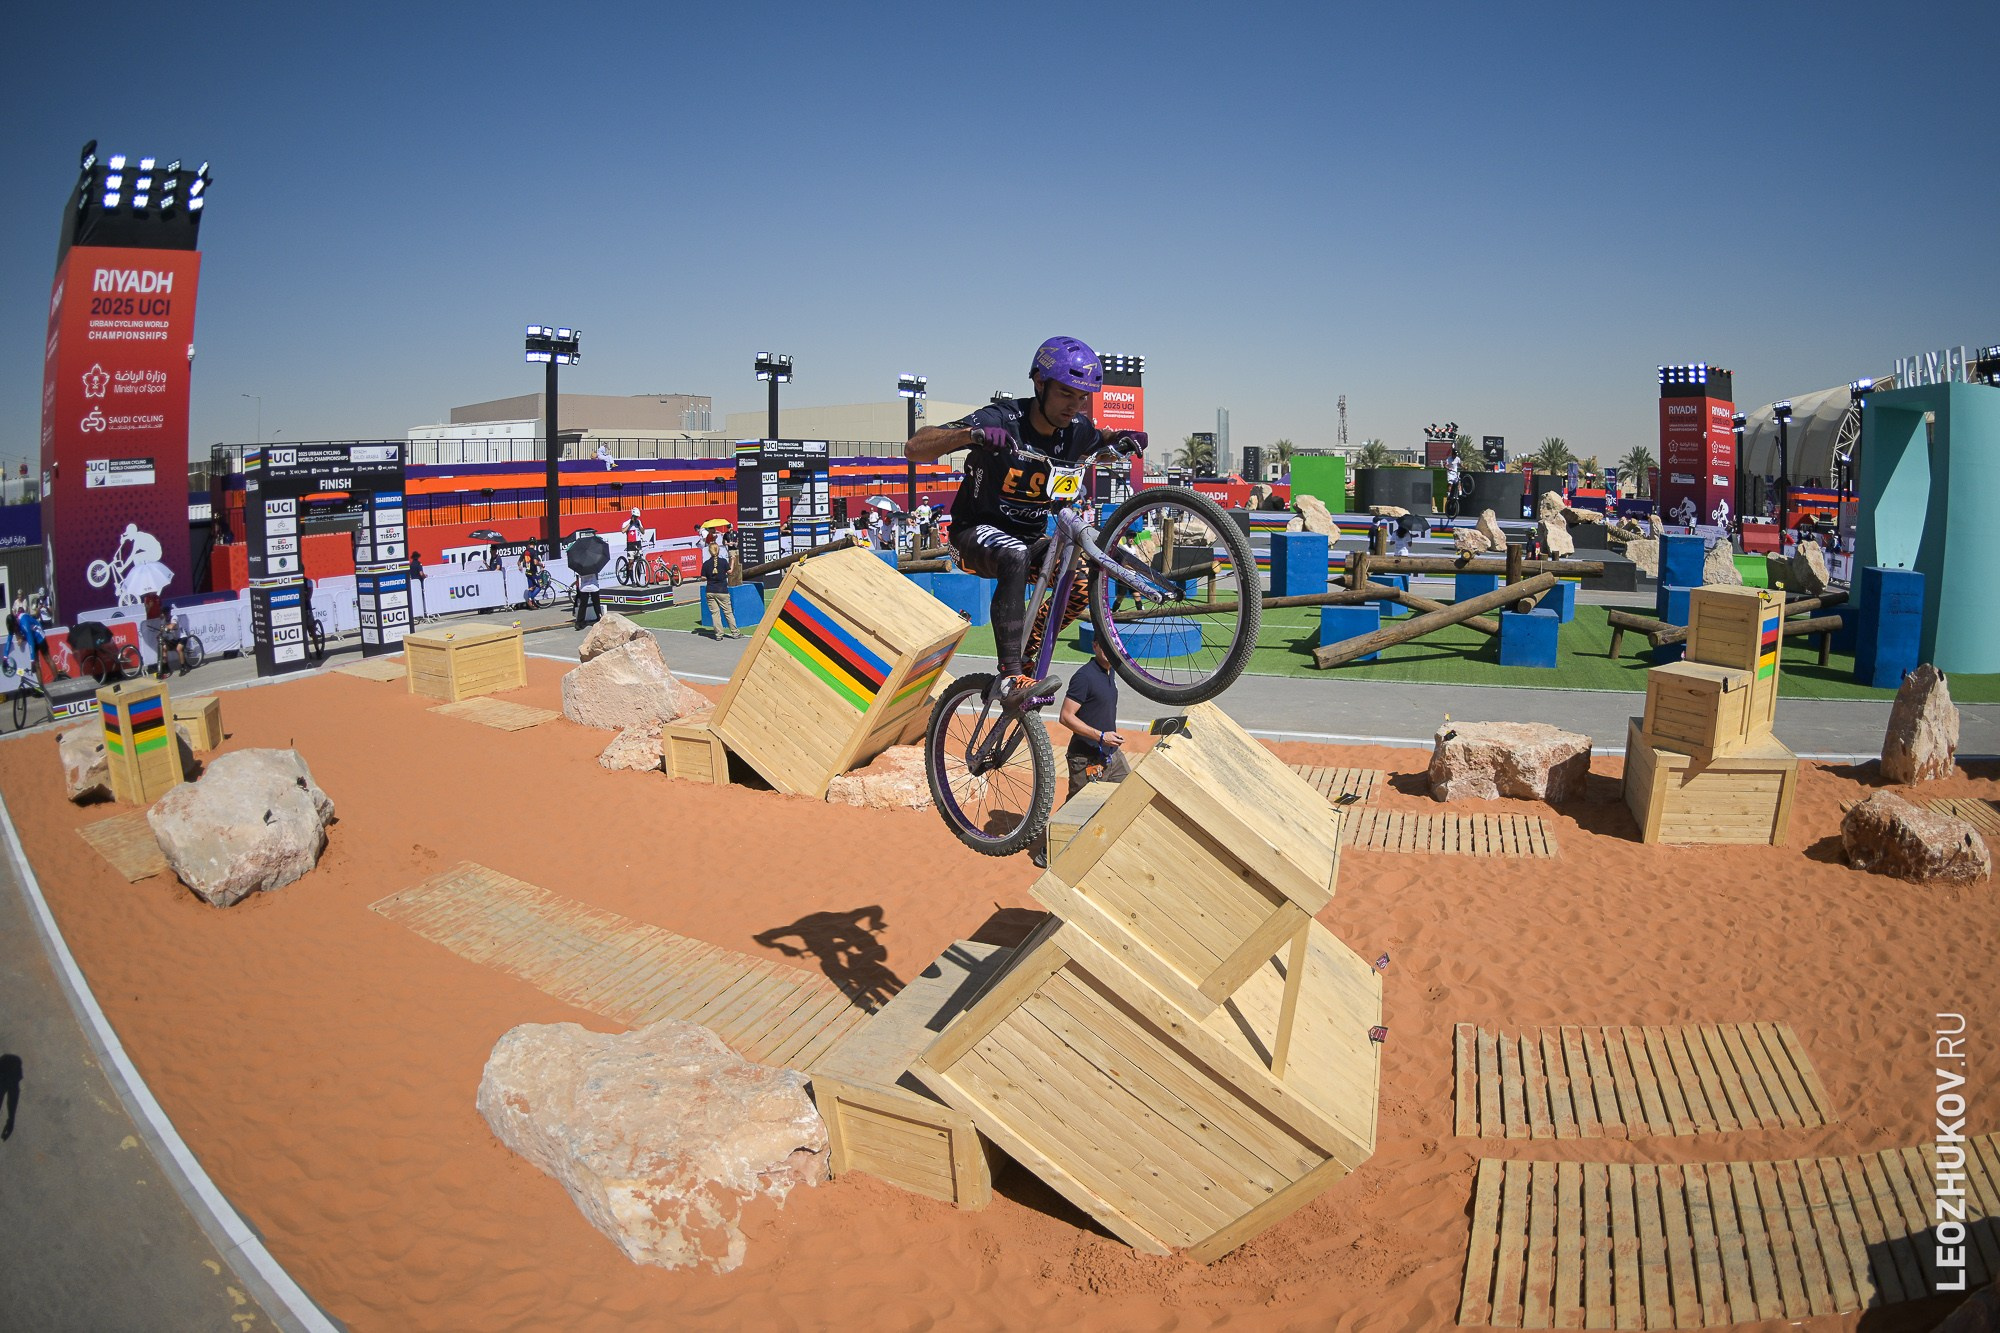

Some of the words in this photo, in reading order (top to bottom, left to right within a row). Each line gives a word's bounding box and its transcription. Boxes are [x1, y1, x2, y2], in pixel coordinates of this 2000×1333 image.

[93, 269, 174, 294] RIYADH
[90, 297, 134, 315] 2025
[138, 299, 171, 316] UCI
[114, 320, 144, 328] CYCLING
[88, 331, 168, 340] CHAMPIONSHIPS
[114, 370, 144, 383] الرياضة
[146, 371, 167, 383] وزارة
[113, 384, 139, 395] Ministry
[139, 384, 147, 393] of
[147, 383, 165, 394] Sport
[1103, 392, 1135, 402] RIYADH
[1668, 405, 1697, 415] RIYADH
[1711, 406, 1730, 418] RIYADH
[108, 416, 131, 424] SAUDI
[132, 414, 164, 423] CYCLING
[274, 452, 294, 463] UCI
[90, 462, 107, 472] UCI
[319, 478, 352, 490] FINISH
[1064, 479, 1073, 492] 3
[375, 496, 403, 504] SHIMANO
[272, 502, 292, 513] UCI
[271, 543, 293, 551] TISSOT
[768, 553, 778, 562] UCI
[380, 579, 406, 587] SHIMANO
[455, 584, 479, 599] UCI
[271, 593, 299, 602] SHIMANO
[650, 594, 663, 602] UCI
[365, 614, 376, 624] UCI
[387, 611, 406, 622] UCI
[279, 628, 300, 641] UCI
[68, 702, 89, 714] UCI
